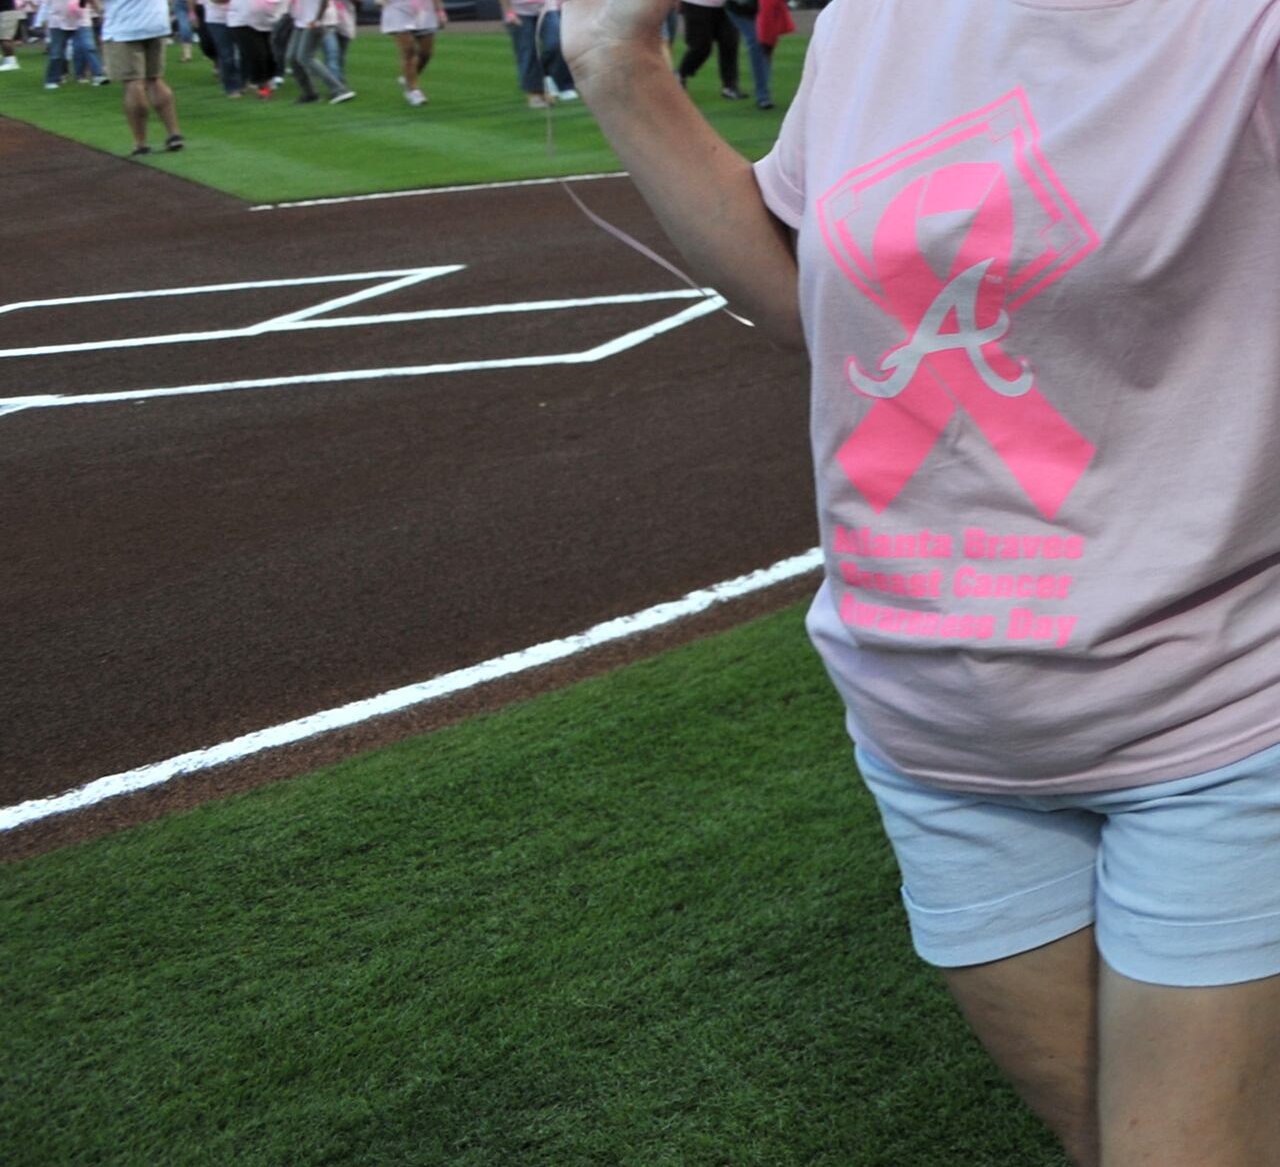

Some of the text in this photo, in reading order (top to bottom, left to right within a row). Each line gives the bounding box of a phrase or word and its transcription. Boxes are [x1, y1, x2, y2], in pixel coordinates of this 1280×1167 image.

[963, 527, 1085, 560] Braves
[953, 565, 1073, 600] Cancer
[1006, 607, 1080, 648] Day
